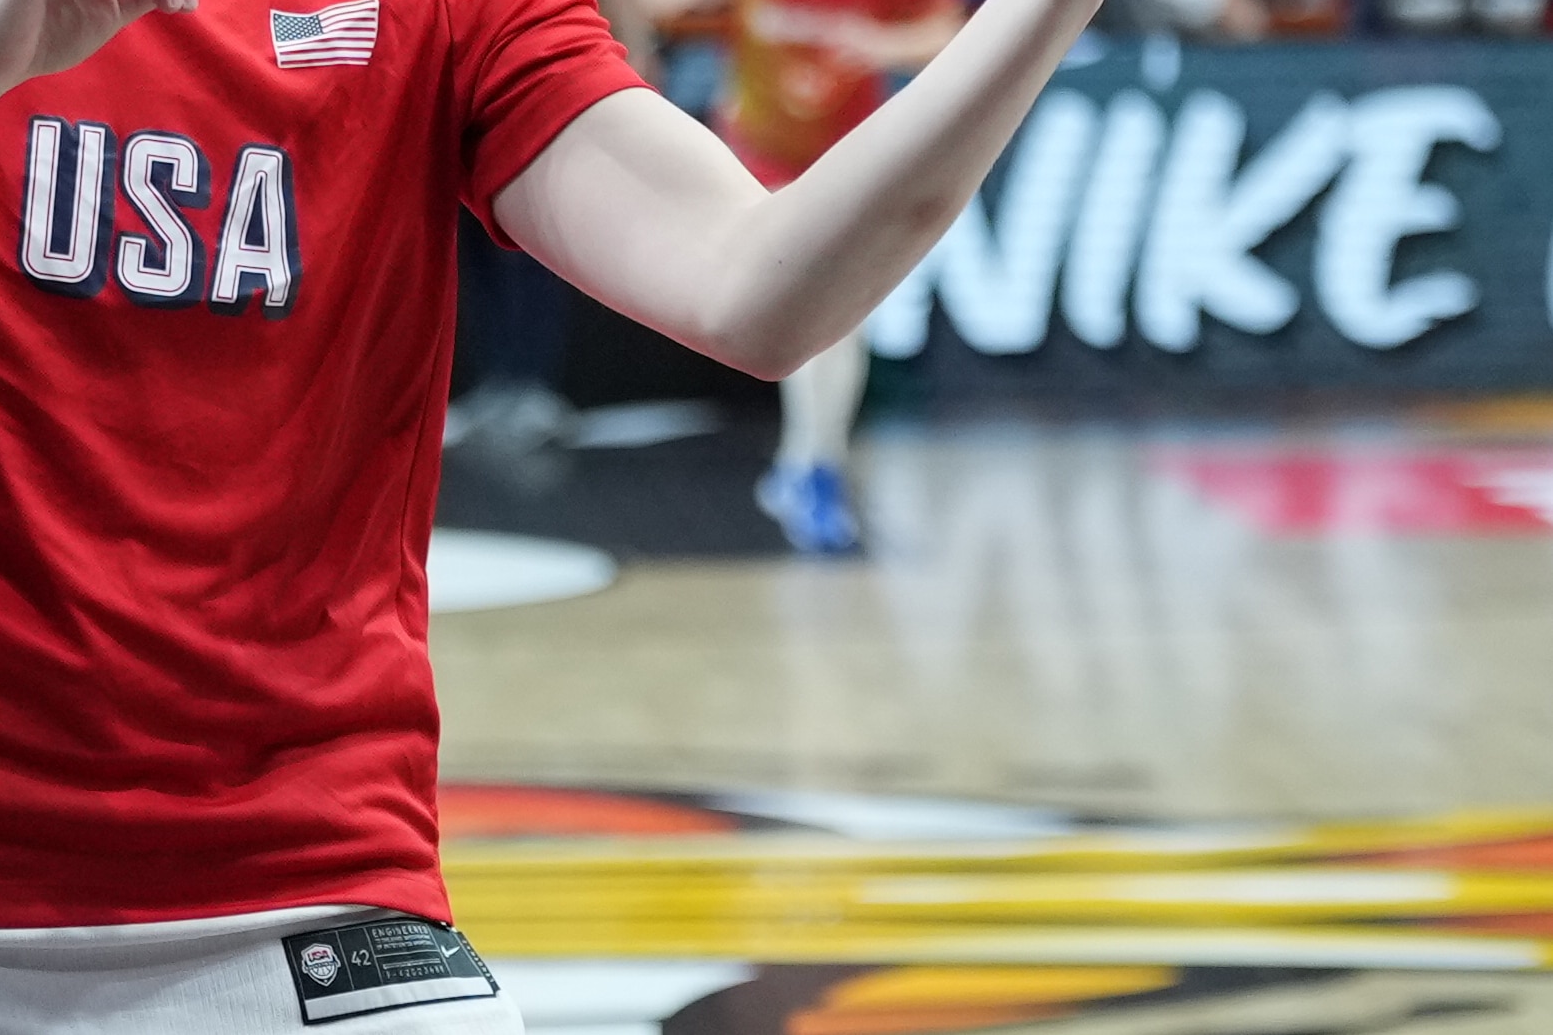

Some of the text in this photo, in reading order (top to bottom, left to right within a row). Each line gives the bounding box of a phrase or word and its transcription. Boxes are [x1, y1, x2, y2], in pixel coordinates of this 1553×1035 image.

[17, 115, 303, 320] USA
[863, 84, 1502, 359] NIKE
[351, 949, 372, 966] 42
[371, 924, 429, 939] ENGINEERED
